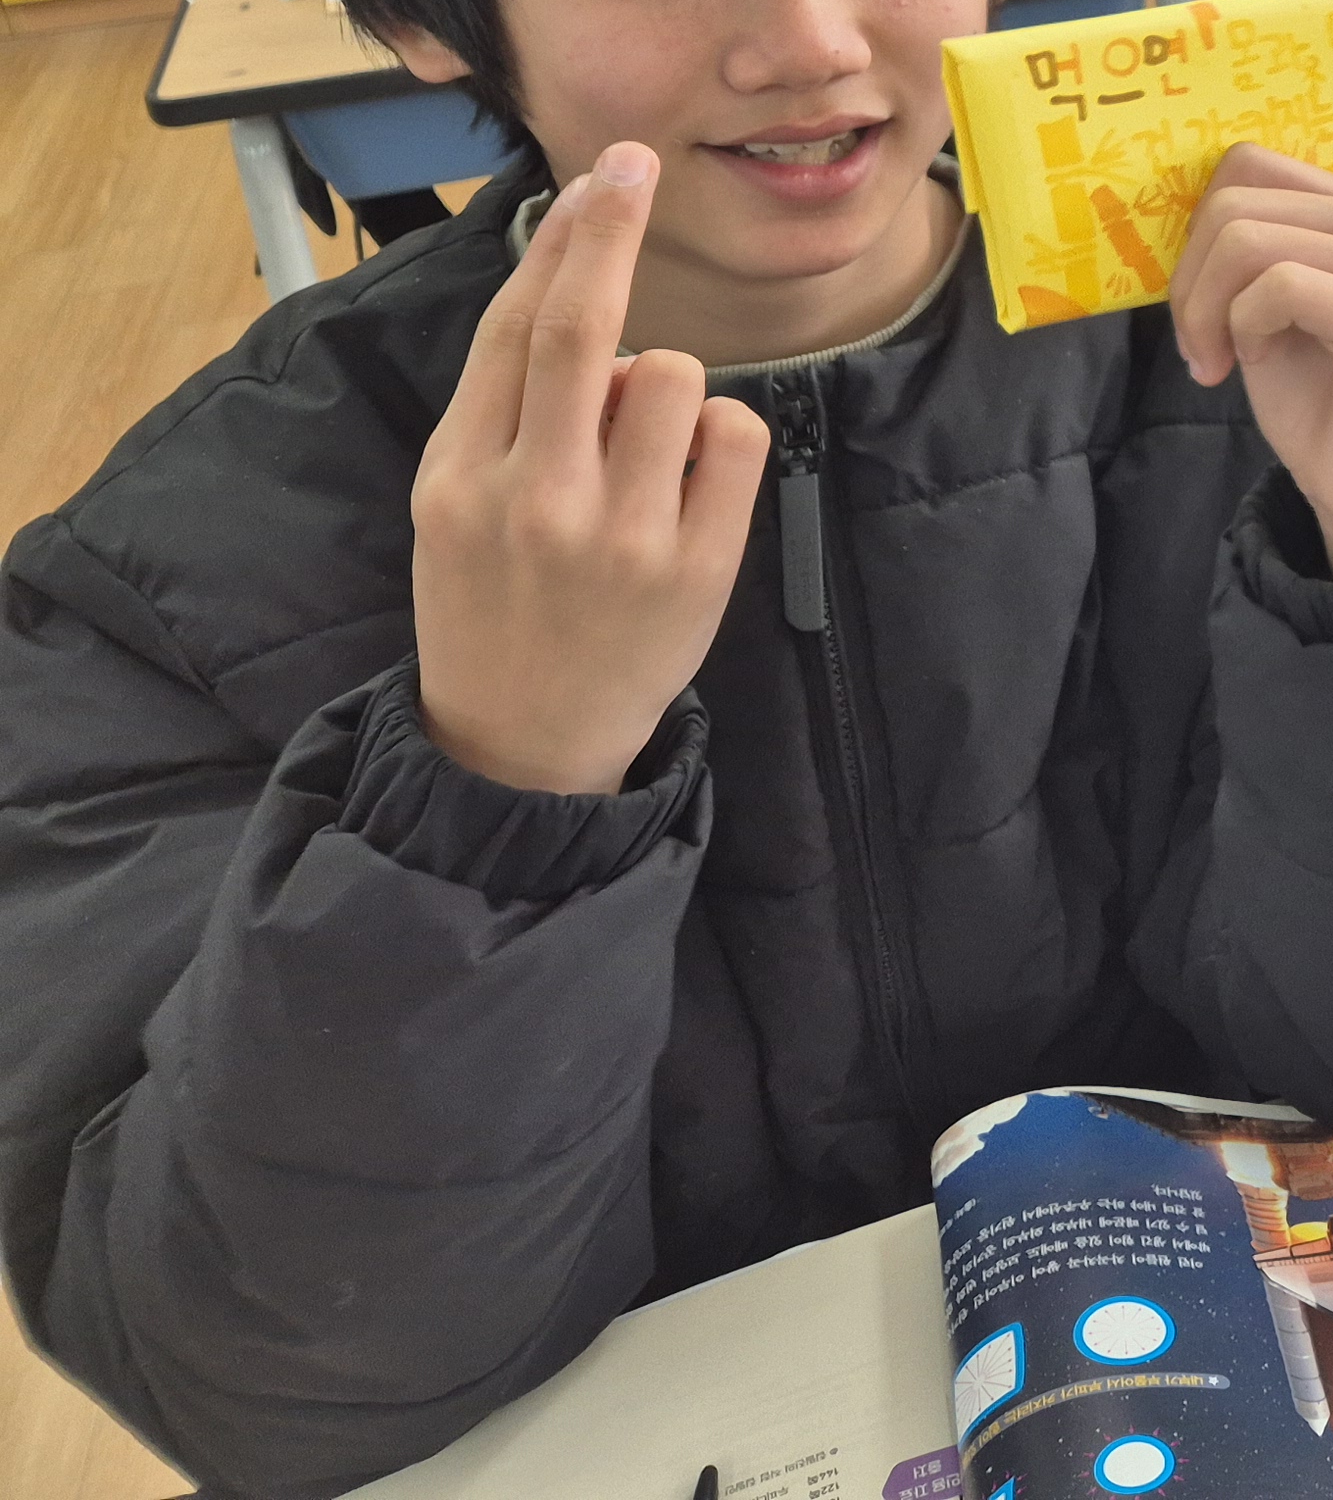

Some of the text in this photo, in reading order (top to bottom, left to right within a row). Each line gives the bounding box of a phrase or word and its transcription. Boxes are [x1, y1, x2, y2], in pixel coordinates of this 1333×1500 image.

[1025, 33, 1190, 122] 먹으면
[1146, 1218, 1170, 1230] 있기
[1176, 1221, 1189, 1232] 수
[913, 1460, 941, 1479] 출처
[932, 1473, 962, 1492] 인용
